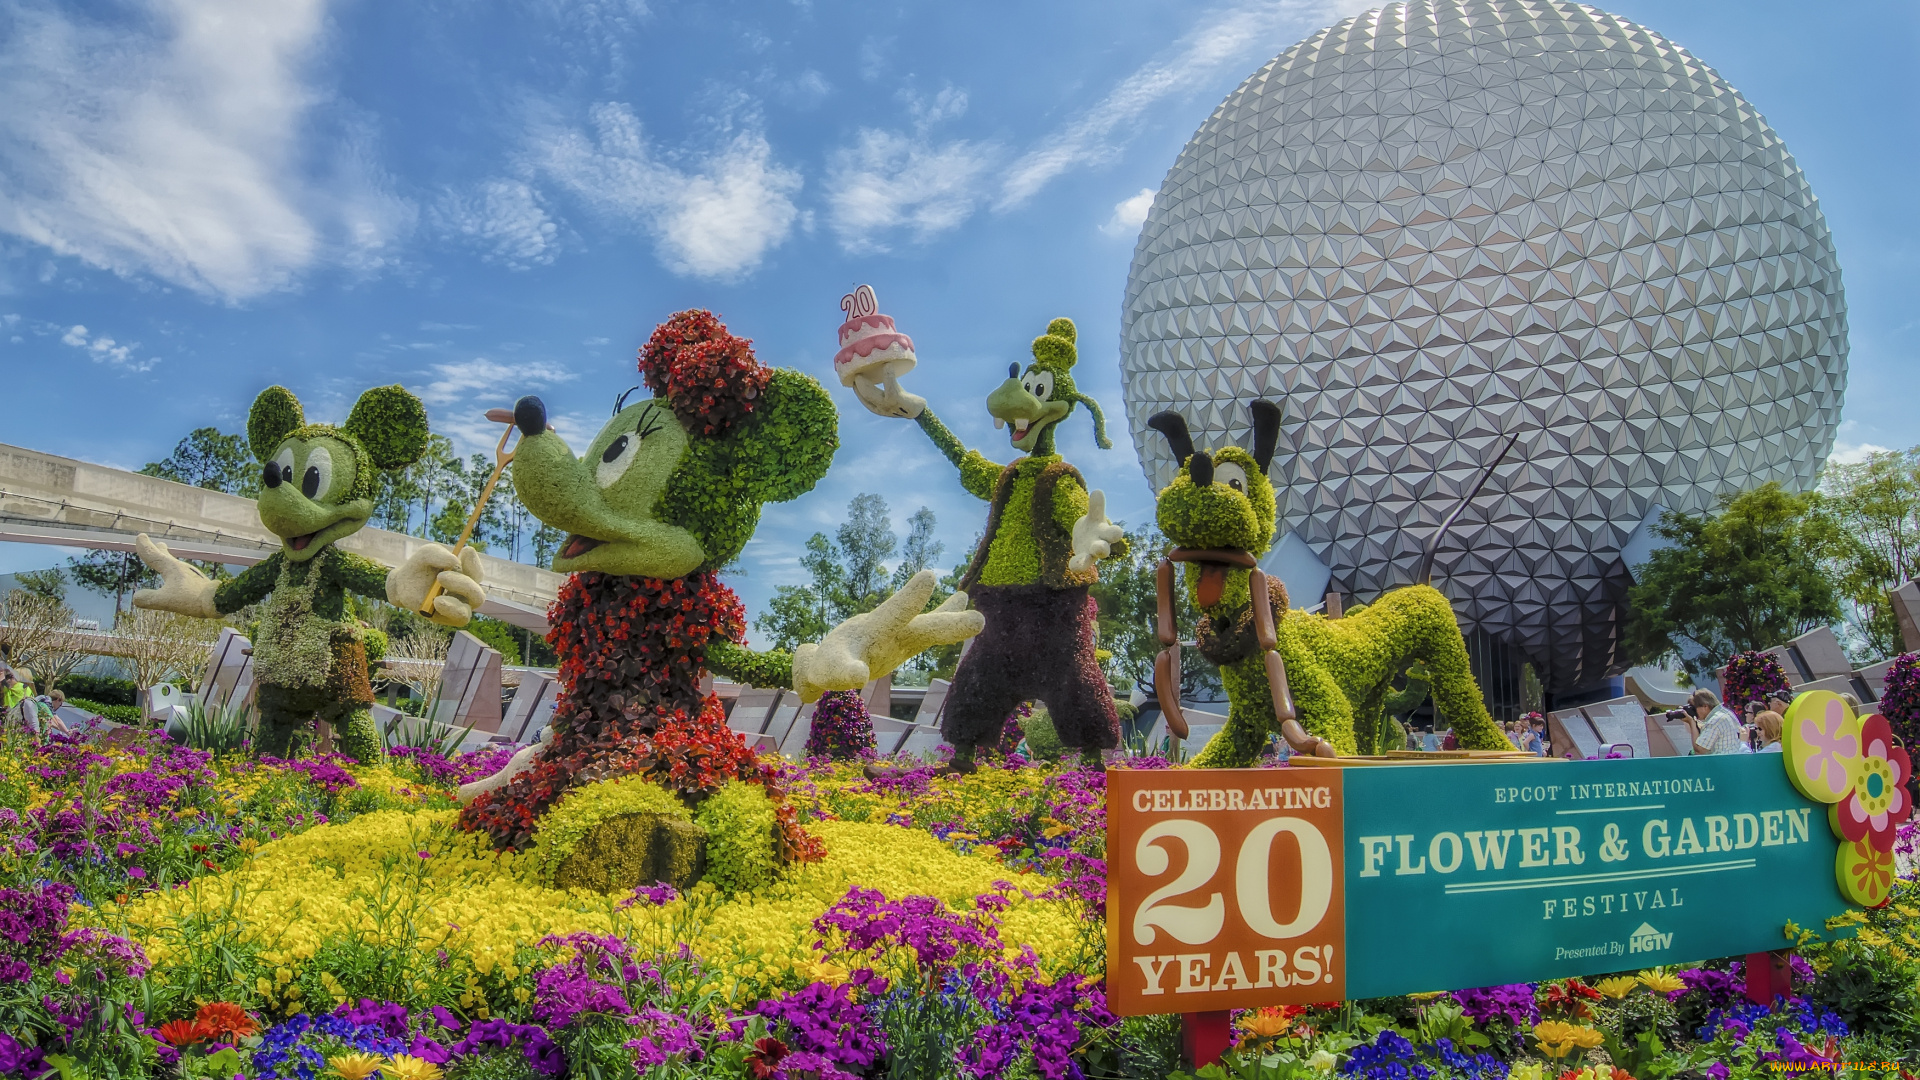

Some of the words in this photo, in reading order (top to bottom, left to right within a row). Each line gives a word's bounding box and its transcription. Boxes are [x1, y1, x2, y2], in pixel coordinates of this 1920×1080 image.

[840, 284, 876, 323] 20
[1132, 787, 1331, 812] CELEBRATING
[1570, 777, 1715, 800] INTERNATIONAL
[1359, 826, 1585, 878] FLOWER
[1599, 823, 1629, 861] &
[1642, 808, 1811, 858] GARDEN
[1133, 816, 1333, 945] 20
[1543, 888, 1684, 919] FESTIVAL
[1555, 943, 1608, 960] Presented
[1609, 941, 1625, 956] By
[1629, 932, 1673, 954] HGTV
[1133, 944, 1333, 995] YEARS!
